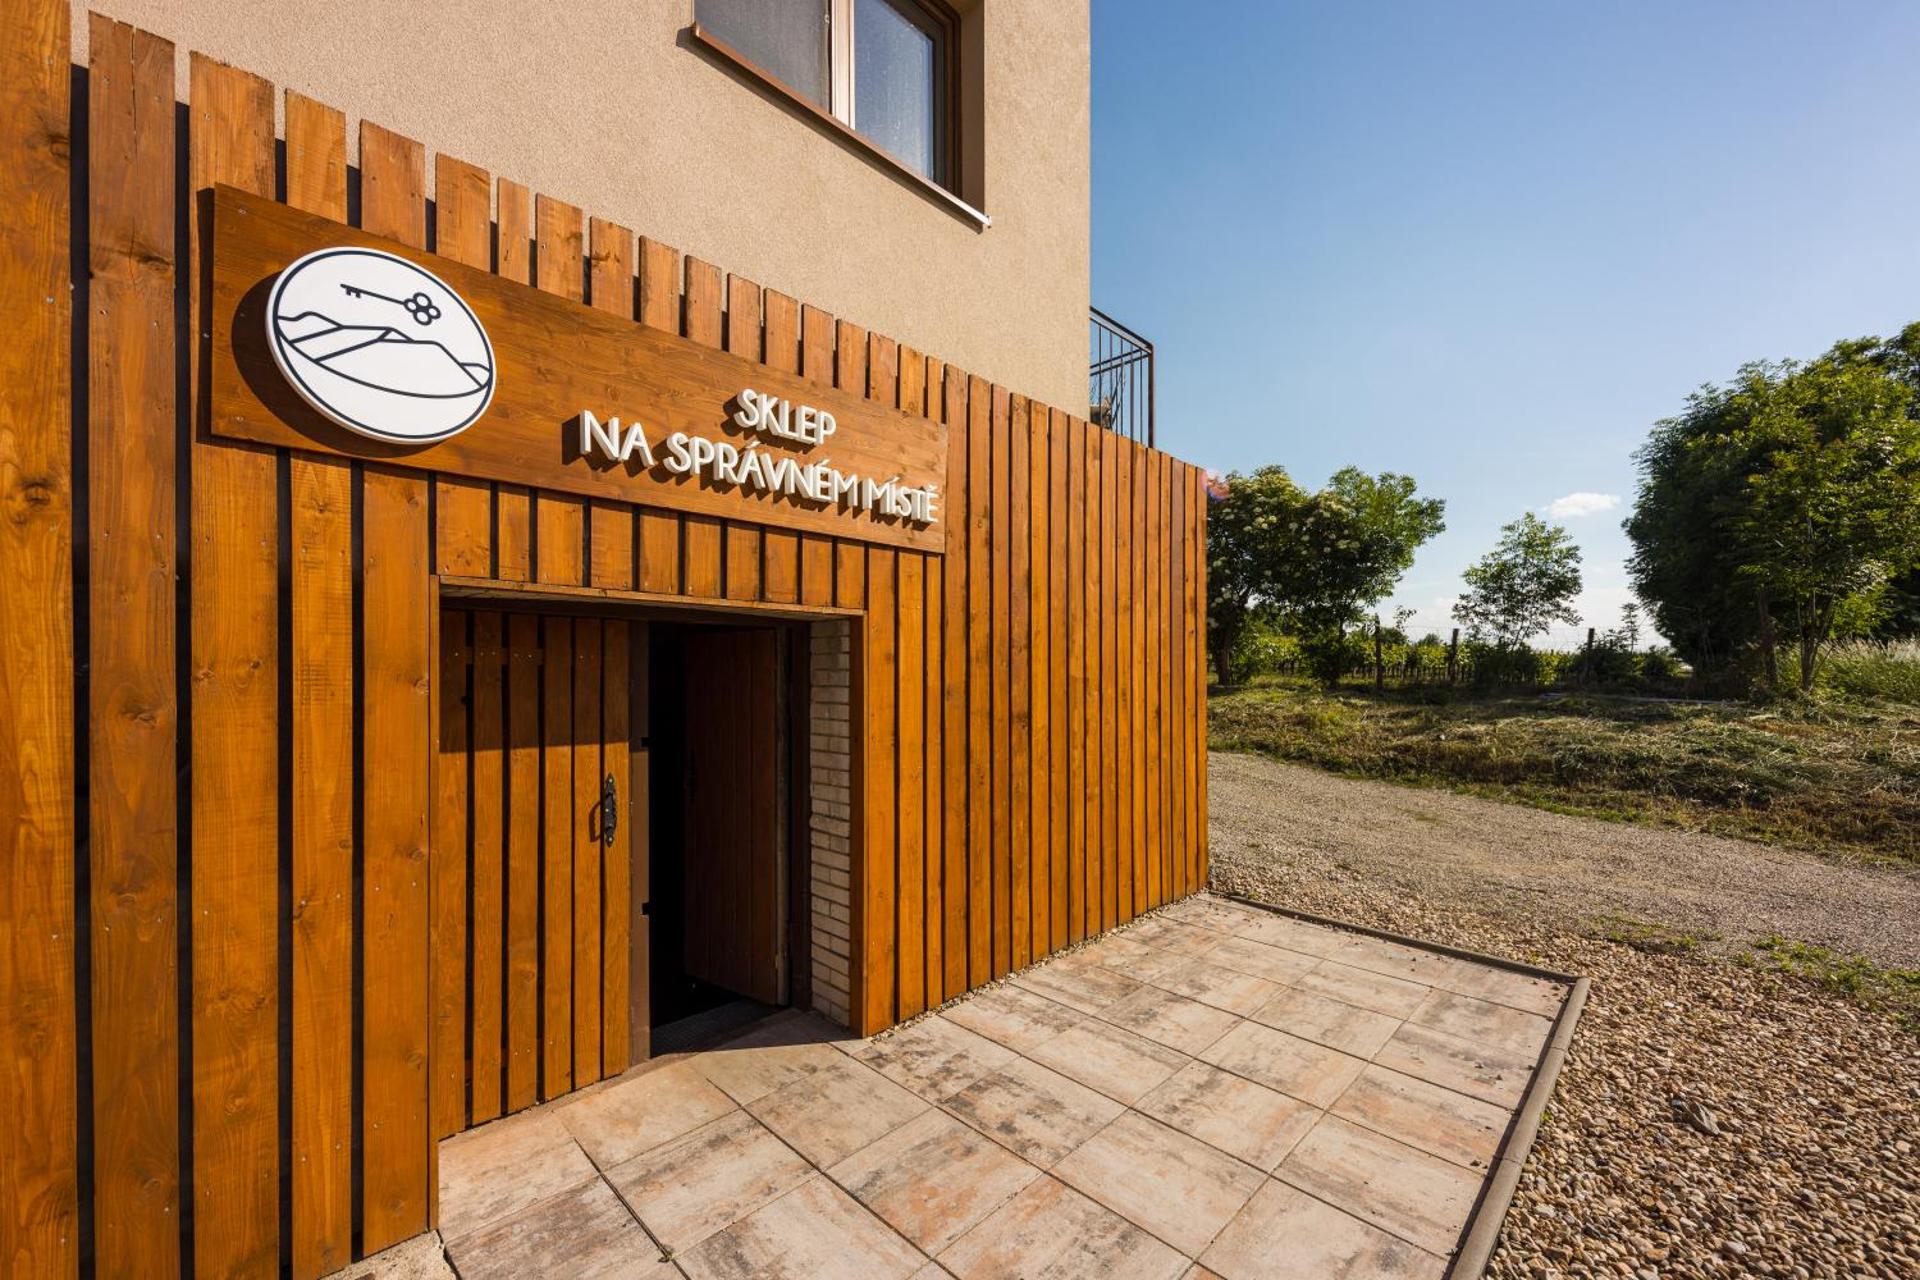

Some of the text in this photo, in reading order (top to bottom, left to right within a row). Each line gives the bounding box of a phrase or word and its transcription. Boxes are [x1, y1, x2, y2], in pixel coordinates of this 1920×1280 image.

[734, 388, 836, 445] SKLEP
[580, 409, 939, 523] NA SPRÁVNÉM MÍSTĚ
